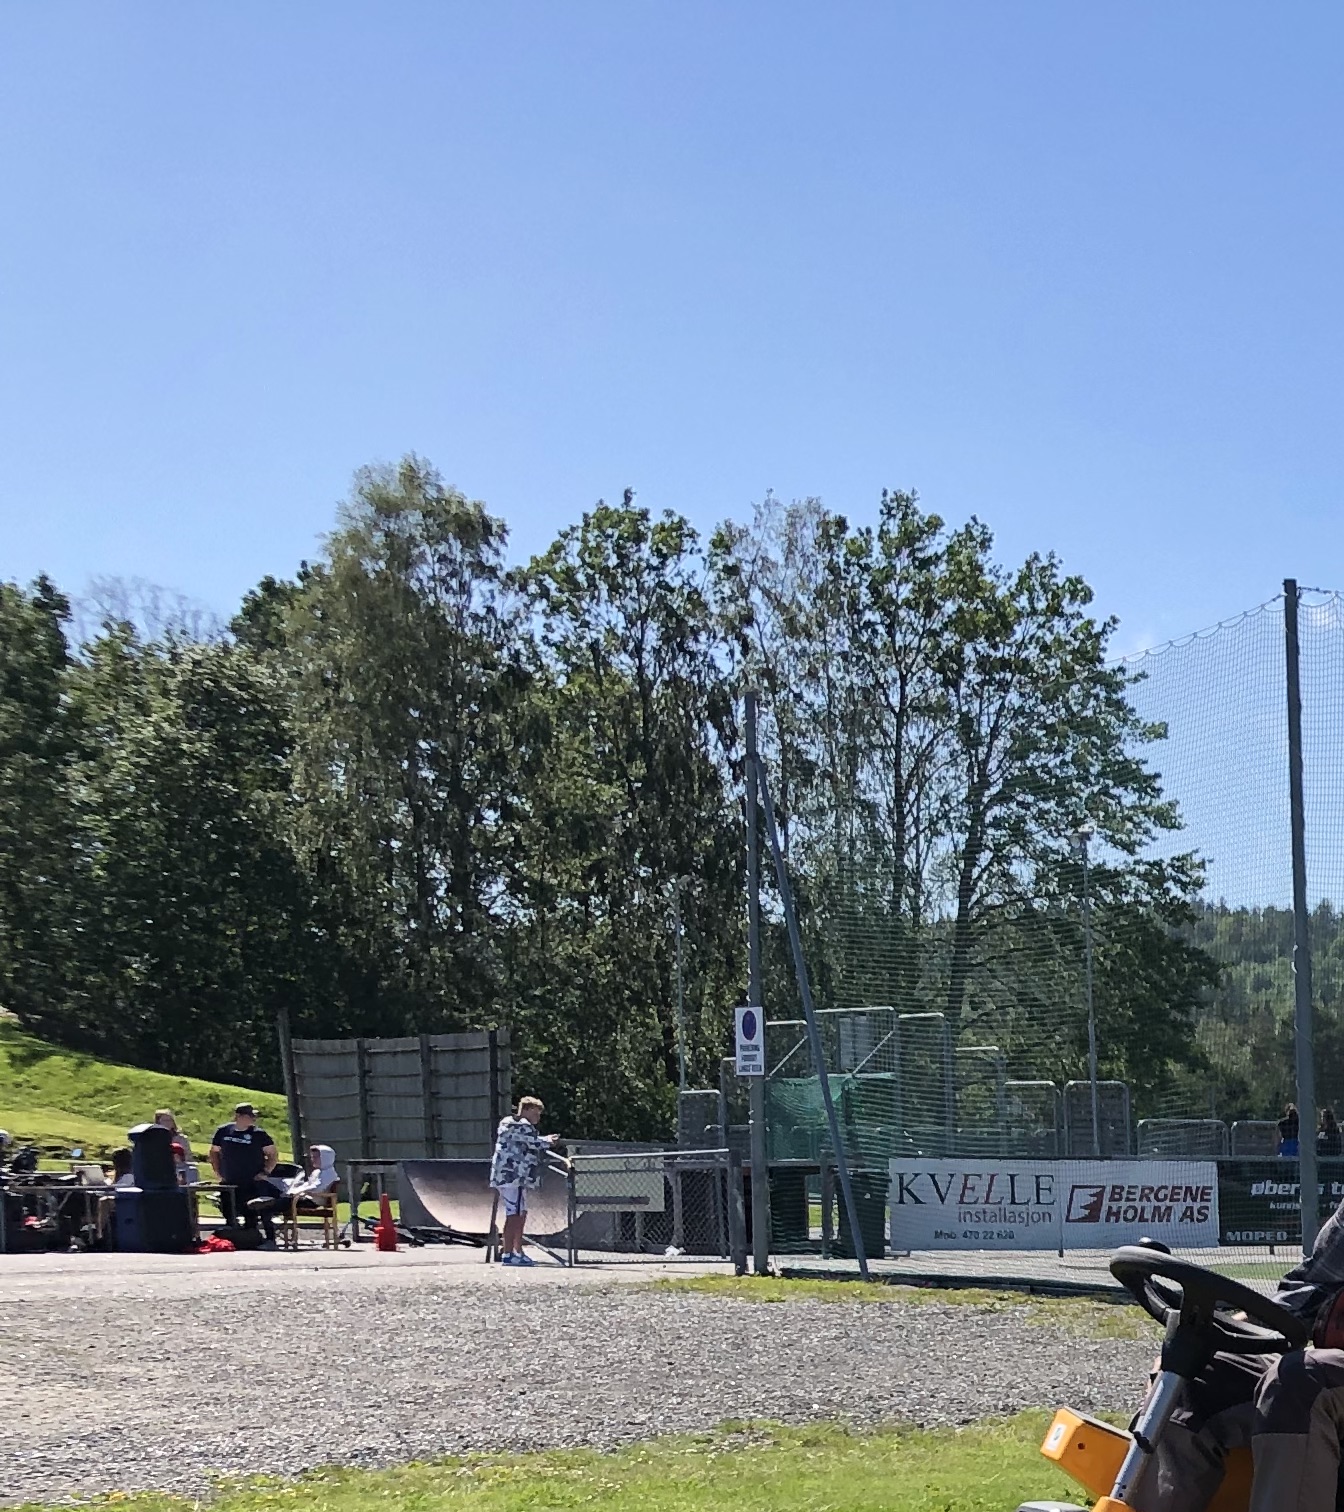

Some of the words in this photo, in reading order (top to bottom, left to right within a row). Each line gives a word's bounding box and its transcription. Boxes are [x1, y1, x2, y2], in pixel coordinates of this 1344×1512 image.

[895, 1172, 1056, 1205] KVELLE
[1108, 1184, 1213, 1203] BERGENE
[958, 1206, 1052, 1227] installasjon
[1105, 1205, 1172, 1223] HOLM
[1179, 1205, 1210, 1223] AS
[1226, 1231, 1288, 1241] MOPED
